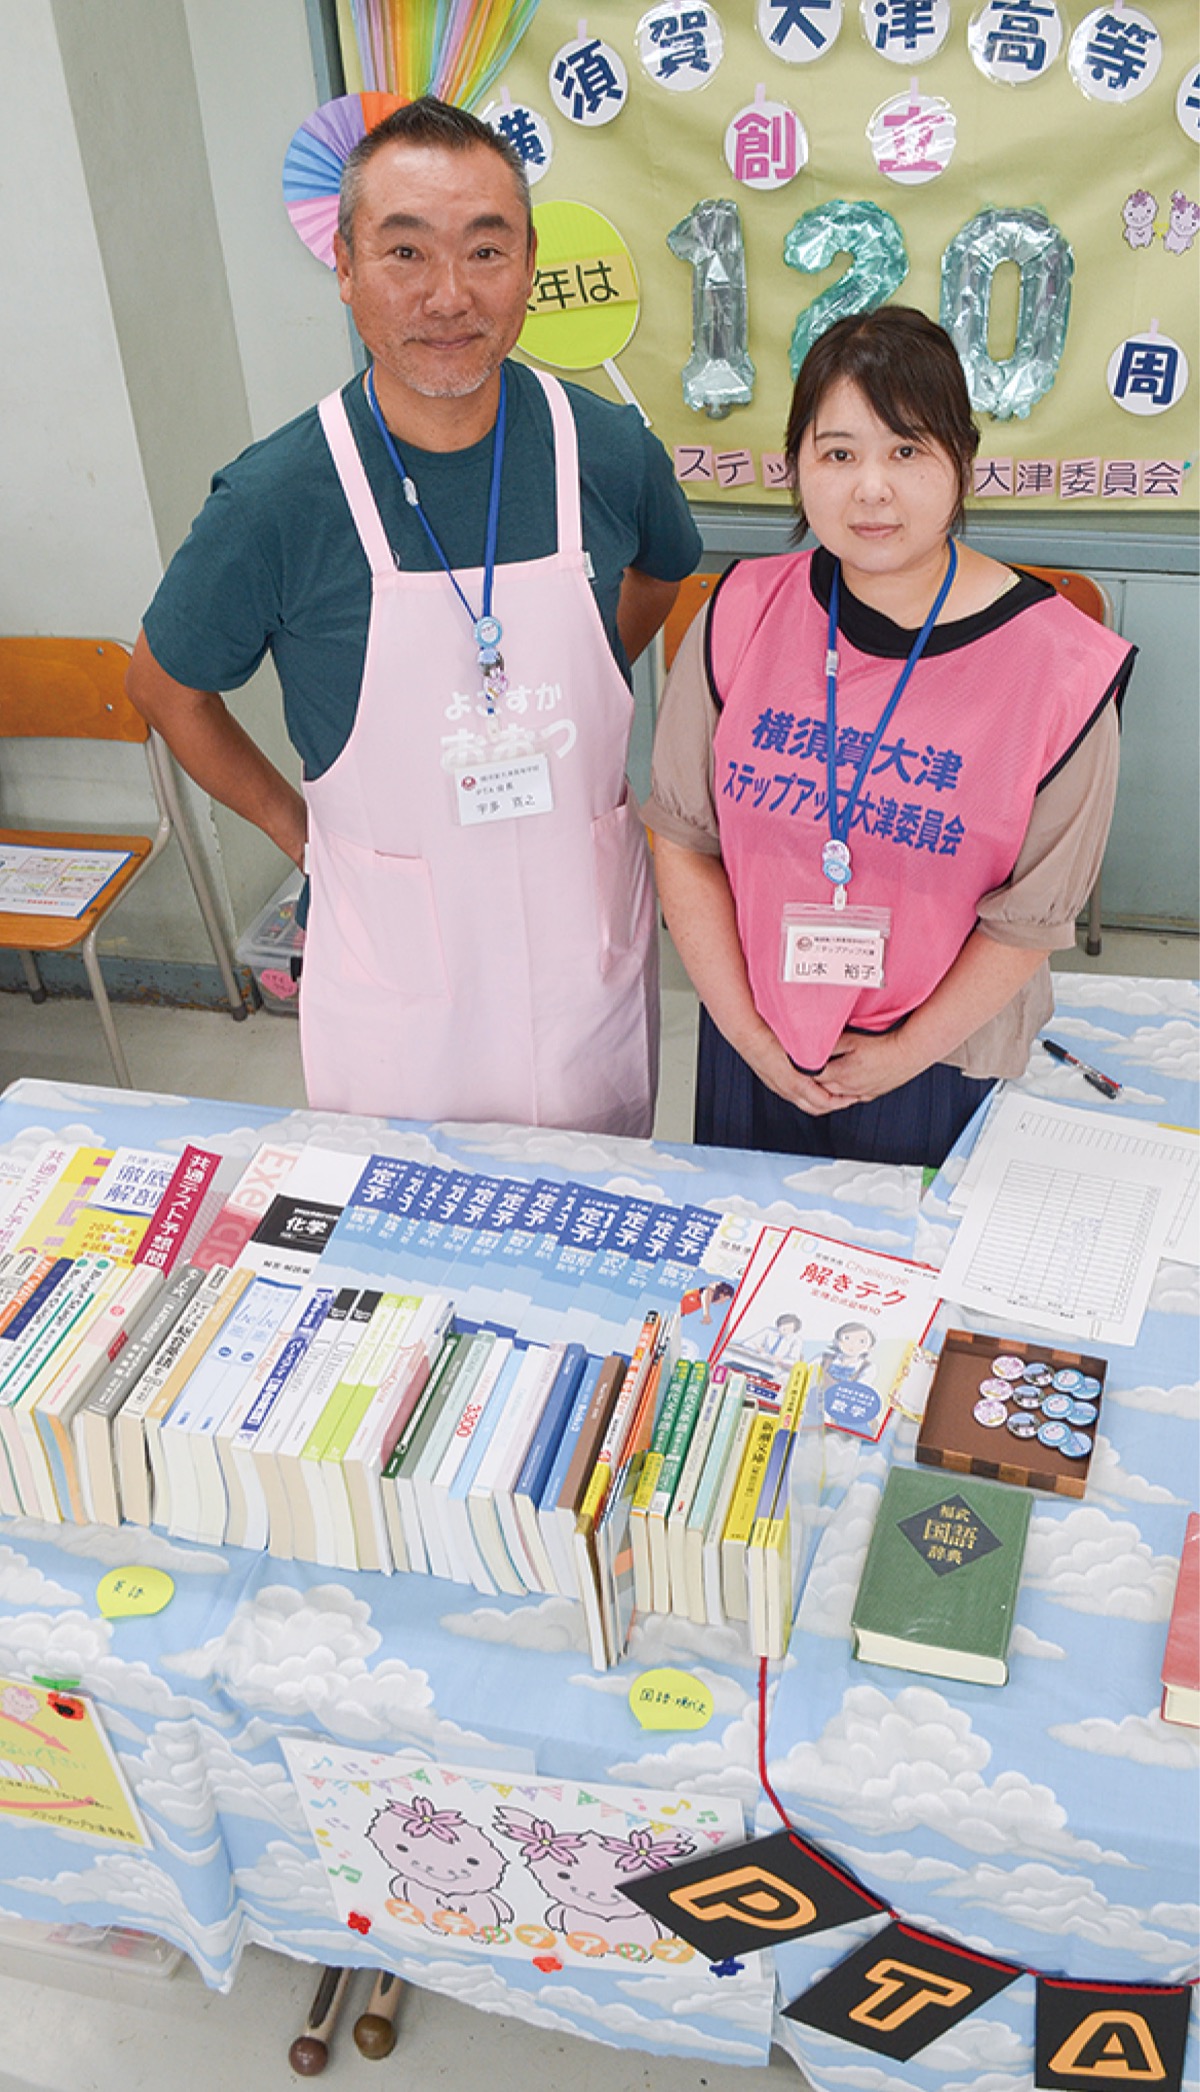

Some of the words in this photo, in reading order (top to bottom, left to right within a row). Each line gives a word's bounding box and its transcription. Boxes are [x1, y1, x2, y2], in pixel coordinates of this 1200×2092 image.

[733, 106, 945, 181] 創立
[525, 259, 621, 312] 年は
[666, 198, 1076, 422] 120
[1113, 342, 1179, 404] 周
[975, 460, 1183, 498] 大津委員会
[751, 707, 963, 793] 横須賀大津
[722, 760, 966, 857] ステップアップ大津委員会
[795, 962, 828, 977] 山本
[285, 1216, 329, 1236] 化学
[799, 1262, 908, 1307] 解きテク
[844, 1259, 911, 1287] Challenge
[454, 1401, 482, 1440] 3300
[922, 1518, 978, 1549] 国語
[926, 1544, 962, 1565] 辞典
